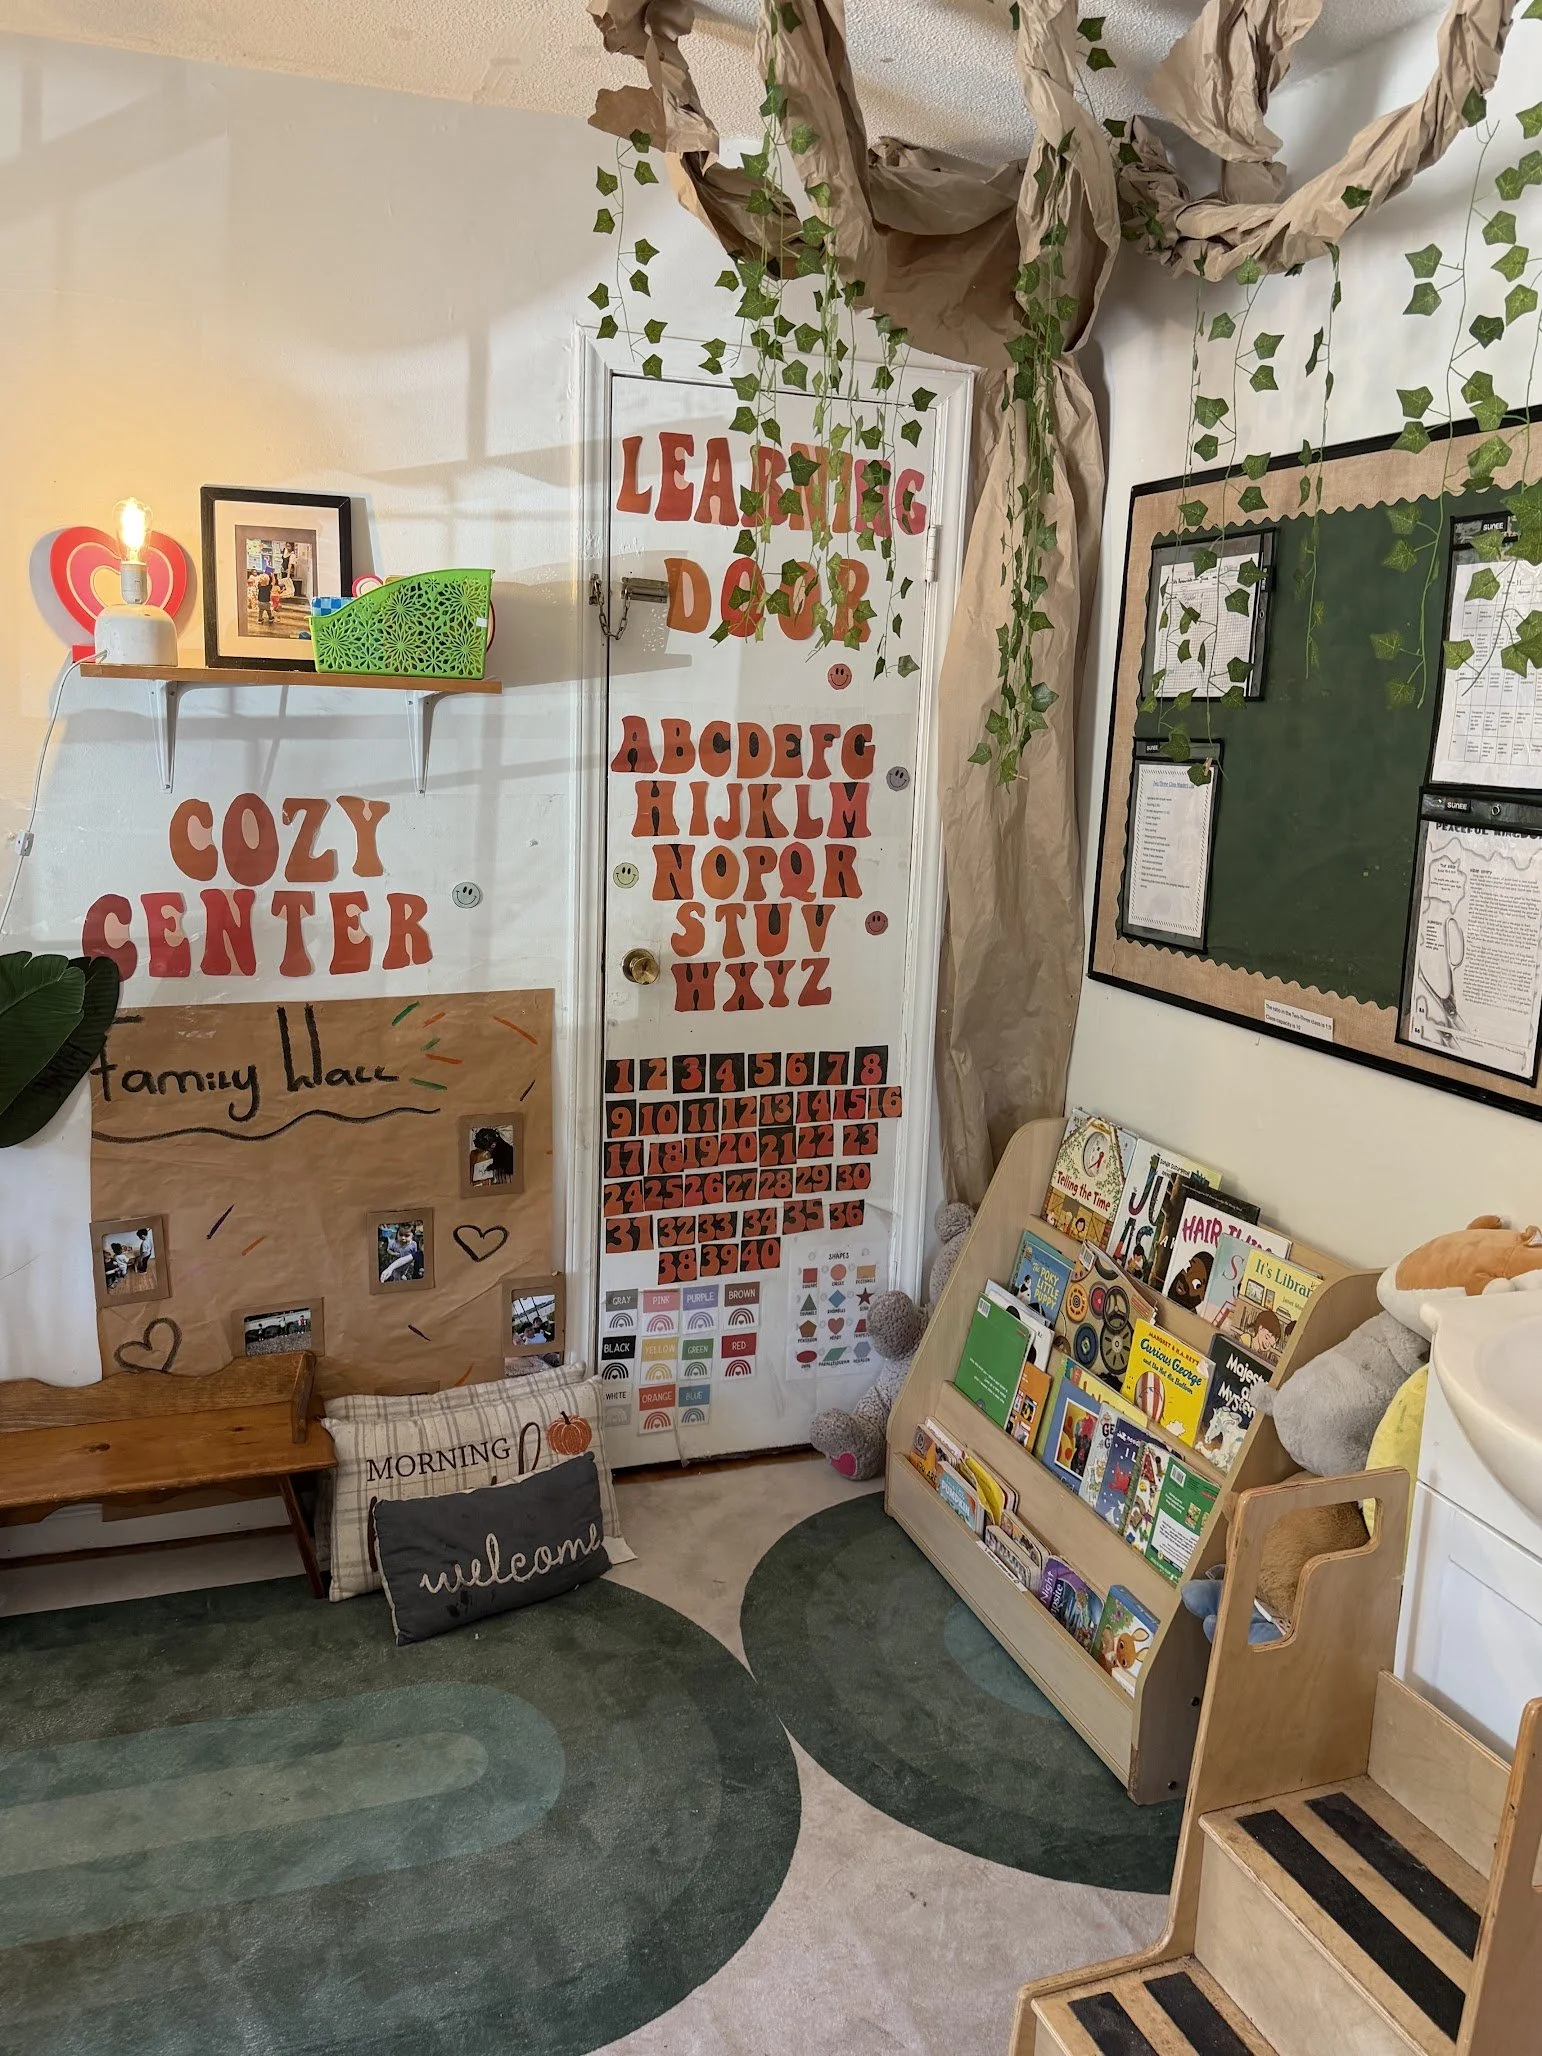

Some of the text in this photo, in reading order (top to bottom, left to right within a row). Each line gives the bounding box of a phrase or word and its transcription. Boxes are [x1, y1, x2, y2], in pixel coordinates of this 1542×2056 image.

[616, 431, 928, 537] LEARNING
[664, 556, 872, 643] DOOR
[168, 792, 391, 887] COZY
[81, 888, 434, 983] CENTER
[614, 1053, 882, 1092] 1 2 3 4 5 6 7 8
[610, 1086, 902, 1137] 9 10 11 12 13 14 15 16
[606, 1123, 878, 1178] 17 18 19 20 21 22 23
[604, 1163, 871, 1217] 24 25 26 27 28 29 30
[1056, 1170, 1112, 1212] Telling the Time
[606, 1198, 864, 1253] 31 32 33 34 35 36
[1182, 1214, 1223, 1249] HAIR
[658, 1238, 781, 1285] 38 39 40
[828, 1252, 850, 1260] SHAPES
[1040, 1267, 1060, 1286] POKY
[612, 1289, 756, 1306] GRAY PINK PURPLE BROWN
[1033, 1288, 1057, 1310] PUPPY
[1036, 1277, 1060, 1301] LITTLE
[1254, 1258, 1273, 1279] It's
[1274, 1267, 1314, 1299] Librar
[603, 1341, 747, 1354] BLACK YELLOW GREEN RED
[1140, 1337, 1203, 1387] Curious George
[1225, 1352, 1269, 1387] Majest
[605, 1391, 703, 1403] WHITE ORANGE BLUE
[365, 1437, 511, 1482] MORNING
[1040, 1569, 1055, 1604] Night
